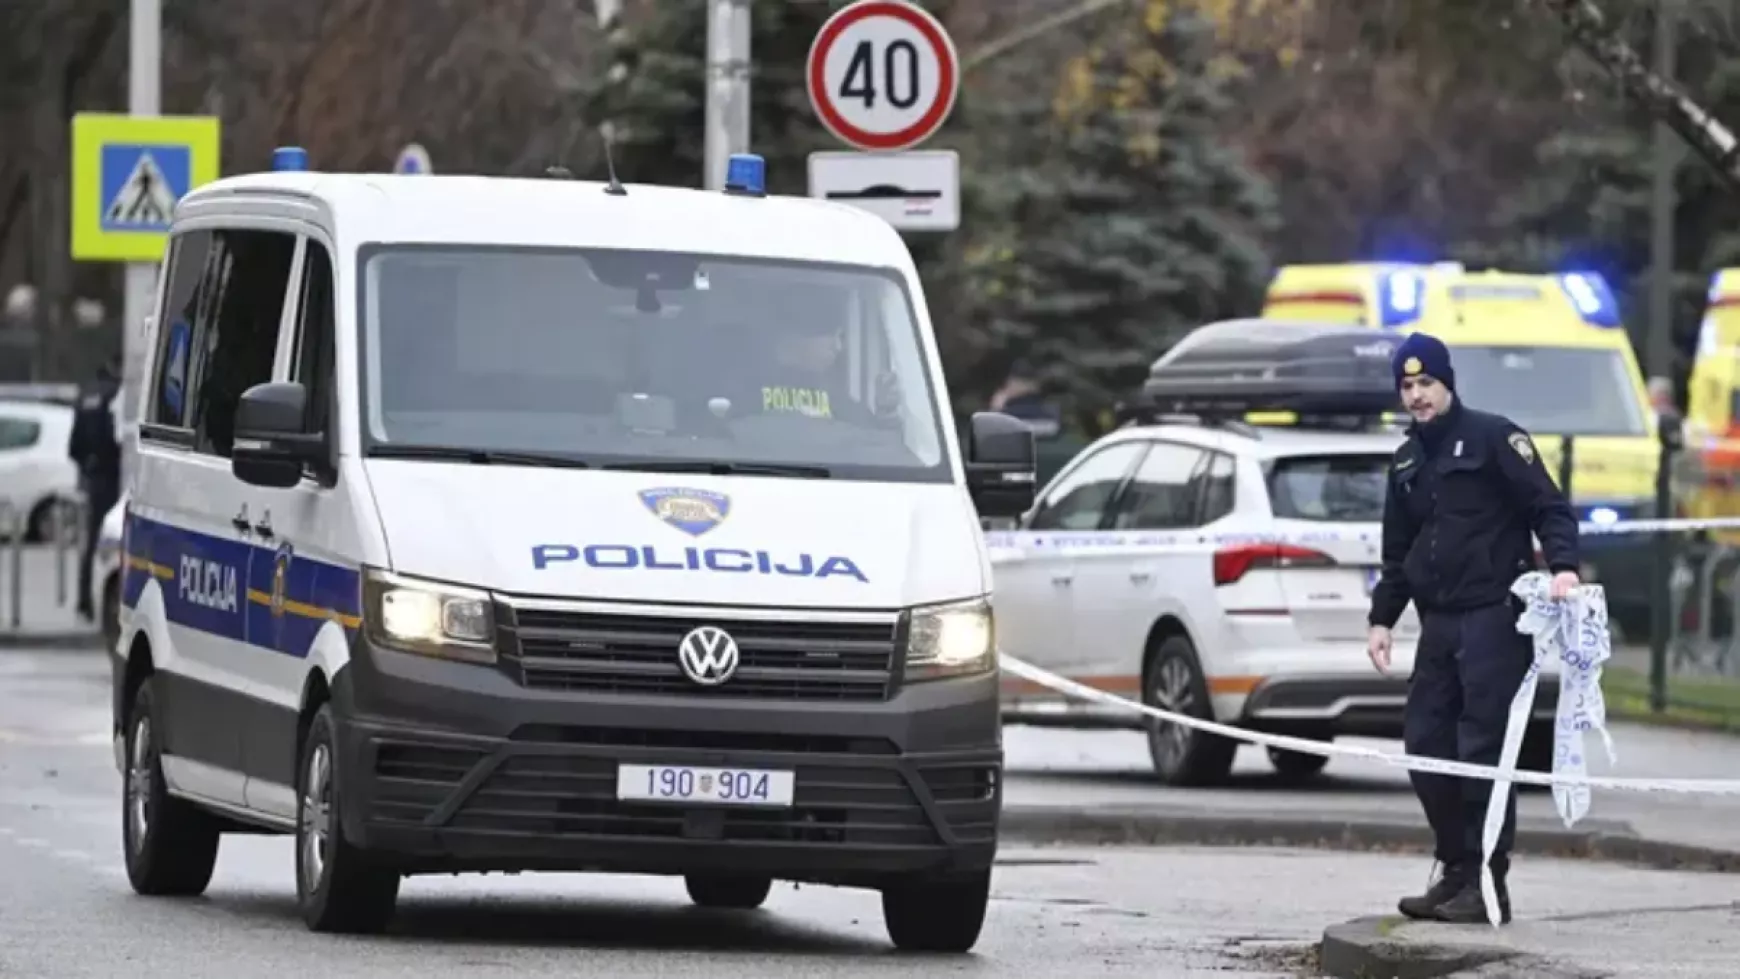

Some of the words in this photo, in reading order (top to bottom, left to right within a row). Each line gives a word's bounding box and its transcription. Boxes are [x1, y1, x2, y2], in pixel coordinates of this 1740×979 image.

[839, 39, 919, 109] 40
[762, 387, 832, 419] POLICIJA
[179, 553, 237, 613] POLICIJA
[531, 544, 870, 583] POLICIJA
[647, 769, 694, 797] 190
[718, 771, 769, 800] 904
